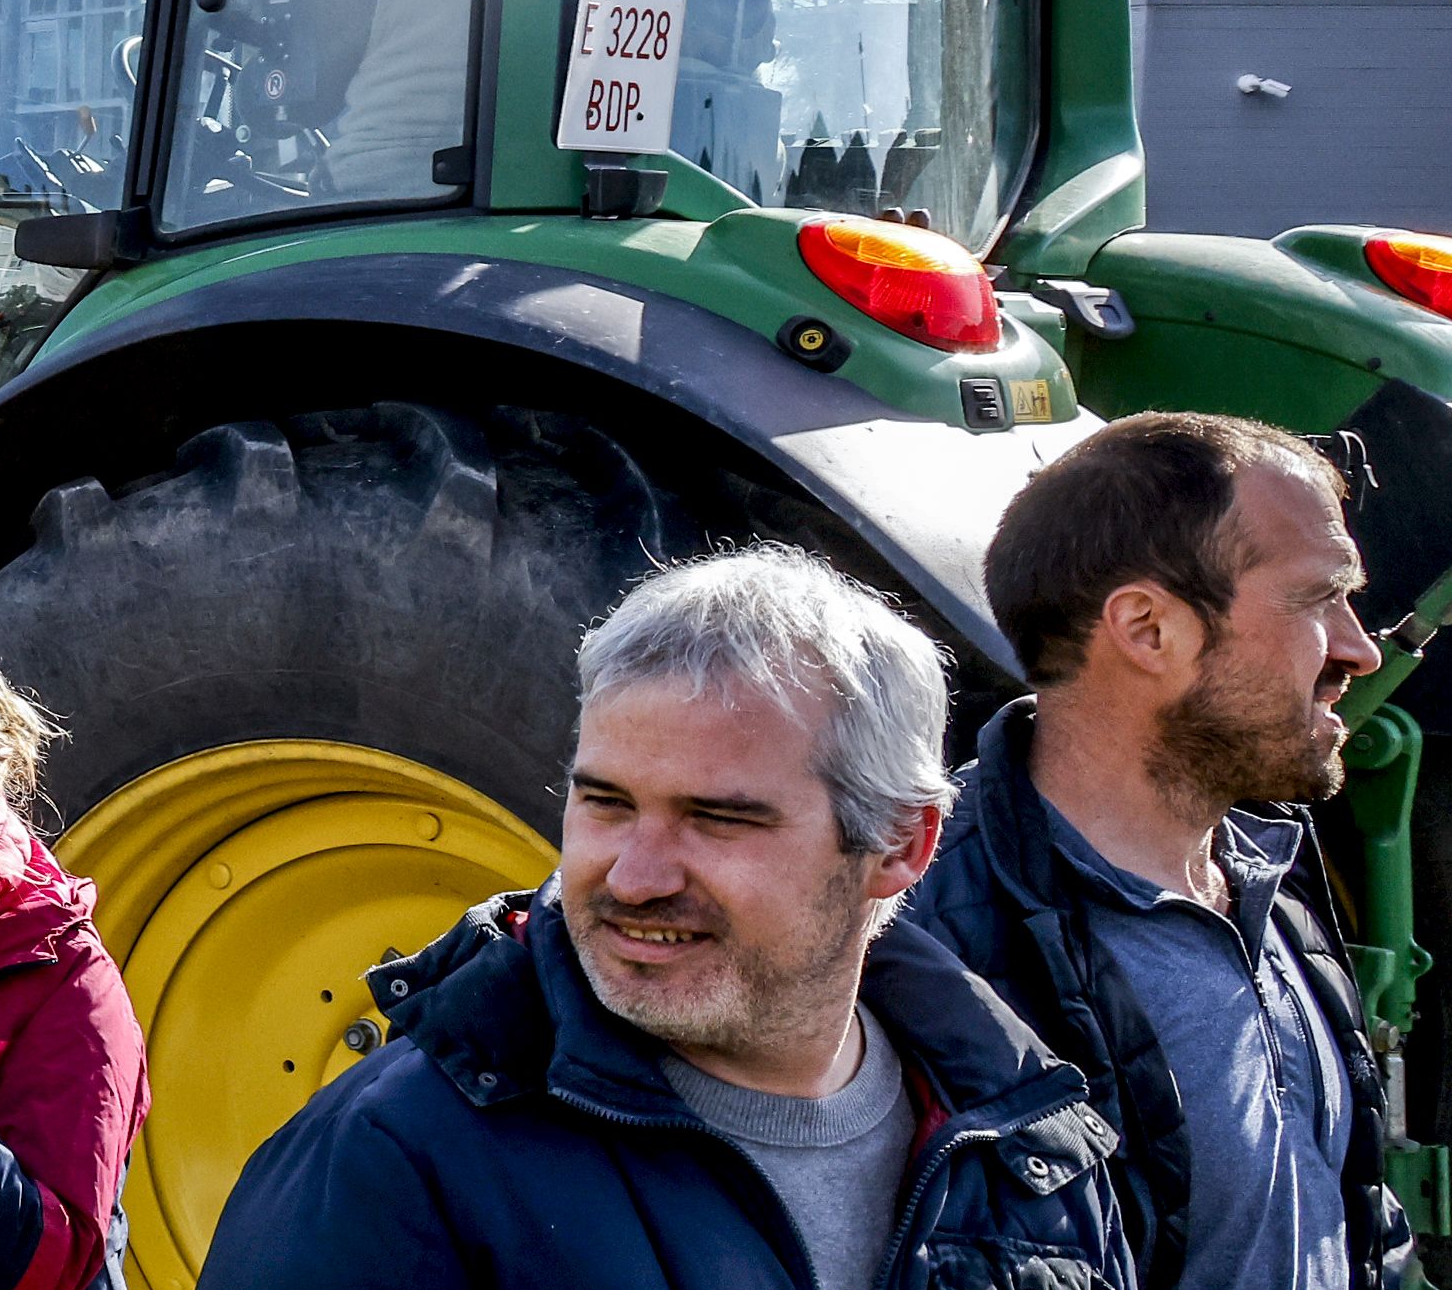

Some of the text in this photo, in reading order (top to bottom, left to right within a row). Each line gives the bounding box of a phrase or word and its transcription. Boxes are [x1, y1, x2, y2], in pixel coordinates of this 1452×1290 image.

[581, 3, 671, 60] E 3228
[586, 79, 641, 132] BDP
